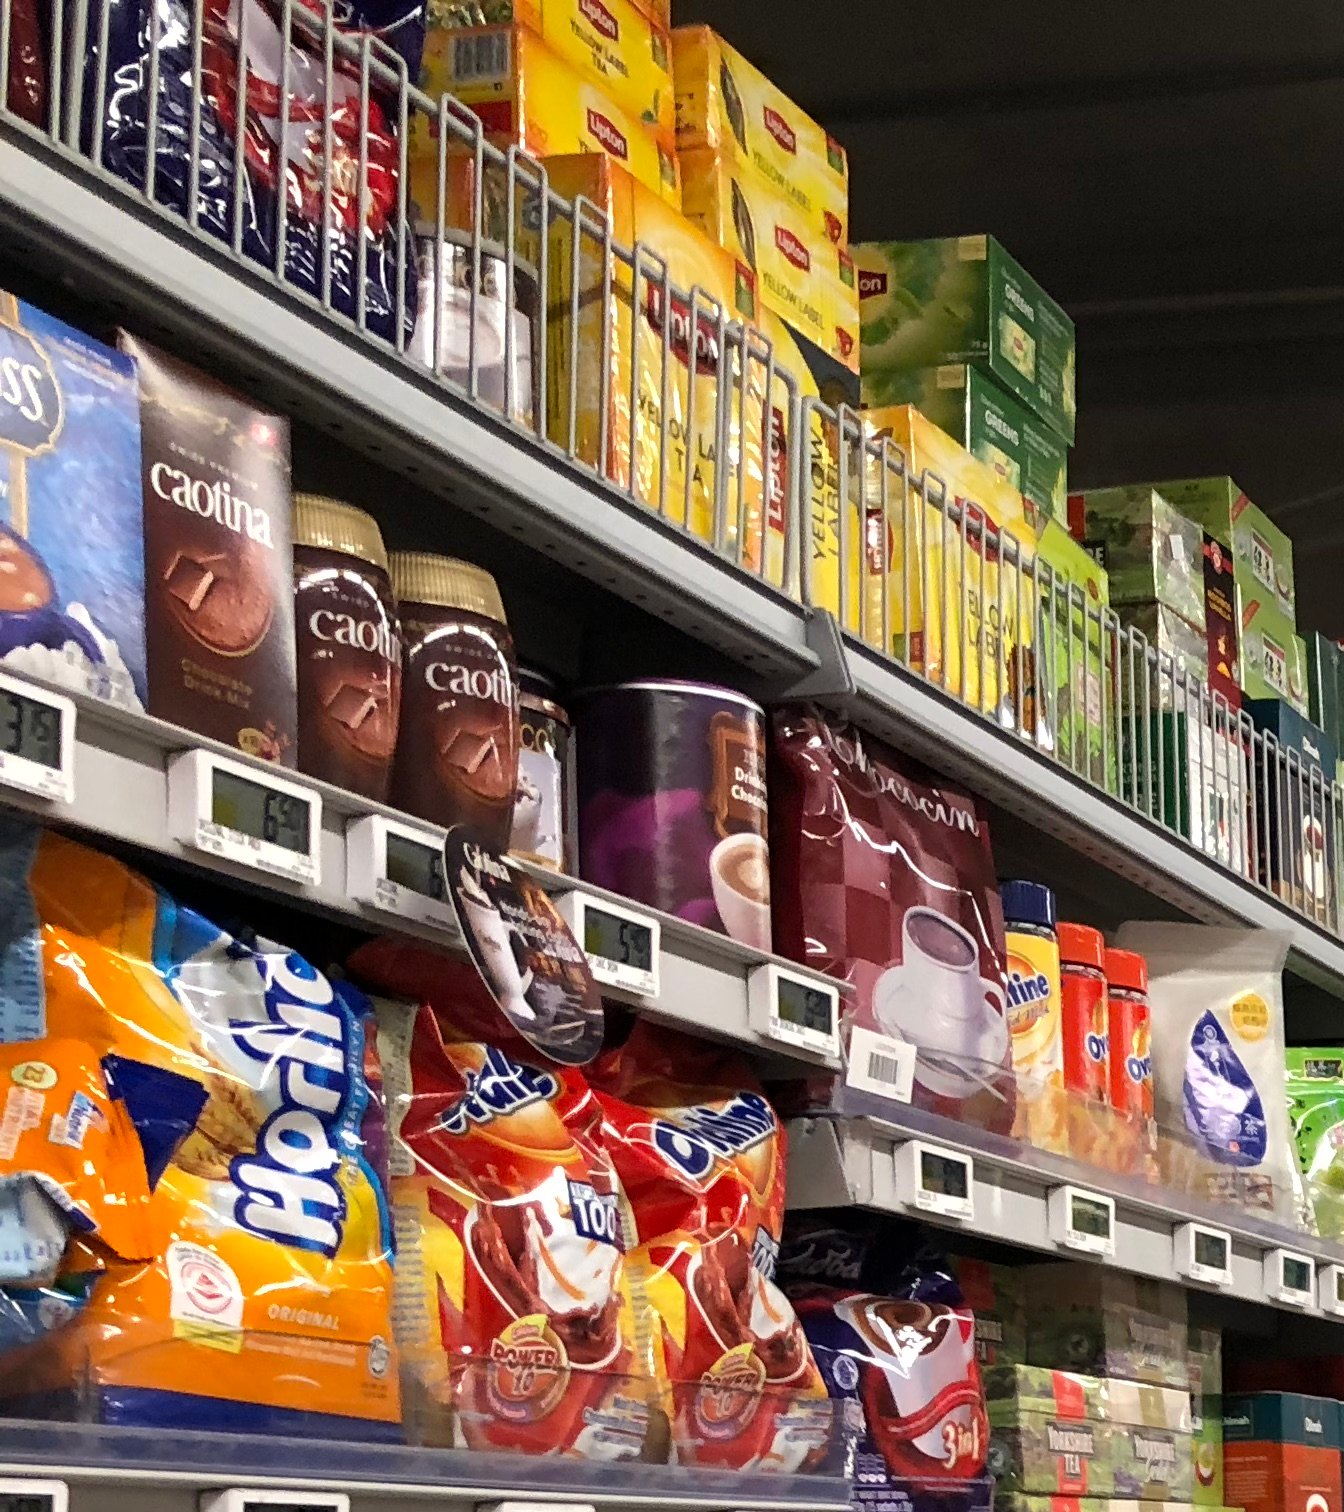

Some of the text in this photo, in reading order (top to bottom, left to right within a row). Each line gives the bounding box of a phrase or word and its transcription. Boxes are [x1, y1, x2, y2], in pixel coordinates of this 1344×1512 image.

[590, 110, 626, 157] Lipton
[764, 110, 796, 153] Lipton
[752, 150, 786, 191] YELLOW
[776, 229, 810, 269] Lipton
[763, 272, 825, 330] YELLOW LABEL
[150, 461, 274, 550] caotina
[1006, 972, 1049, 1008] tine
[267, 1303, 340, 1332] ORIGINAL
[490, 1340, 558, 1373] POWER
[1063, 1454, 1082, 1479] TEA
